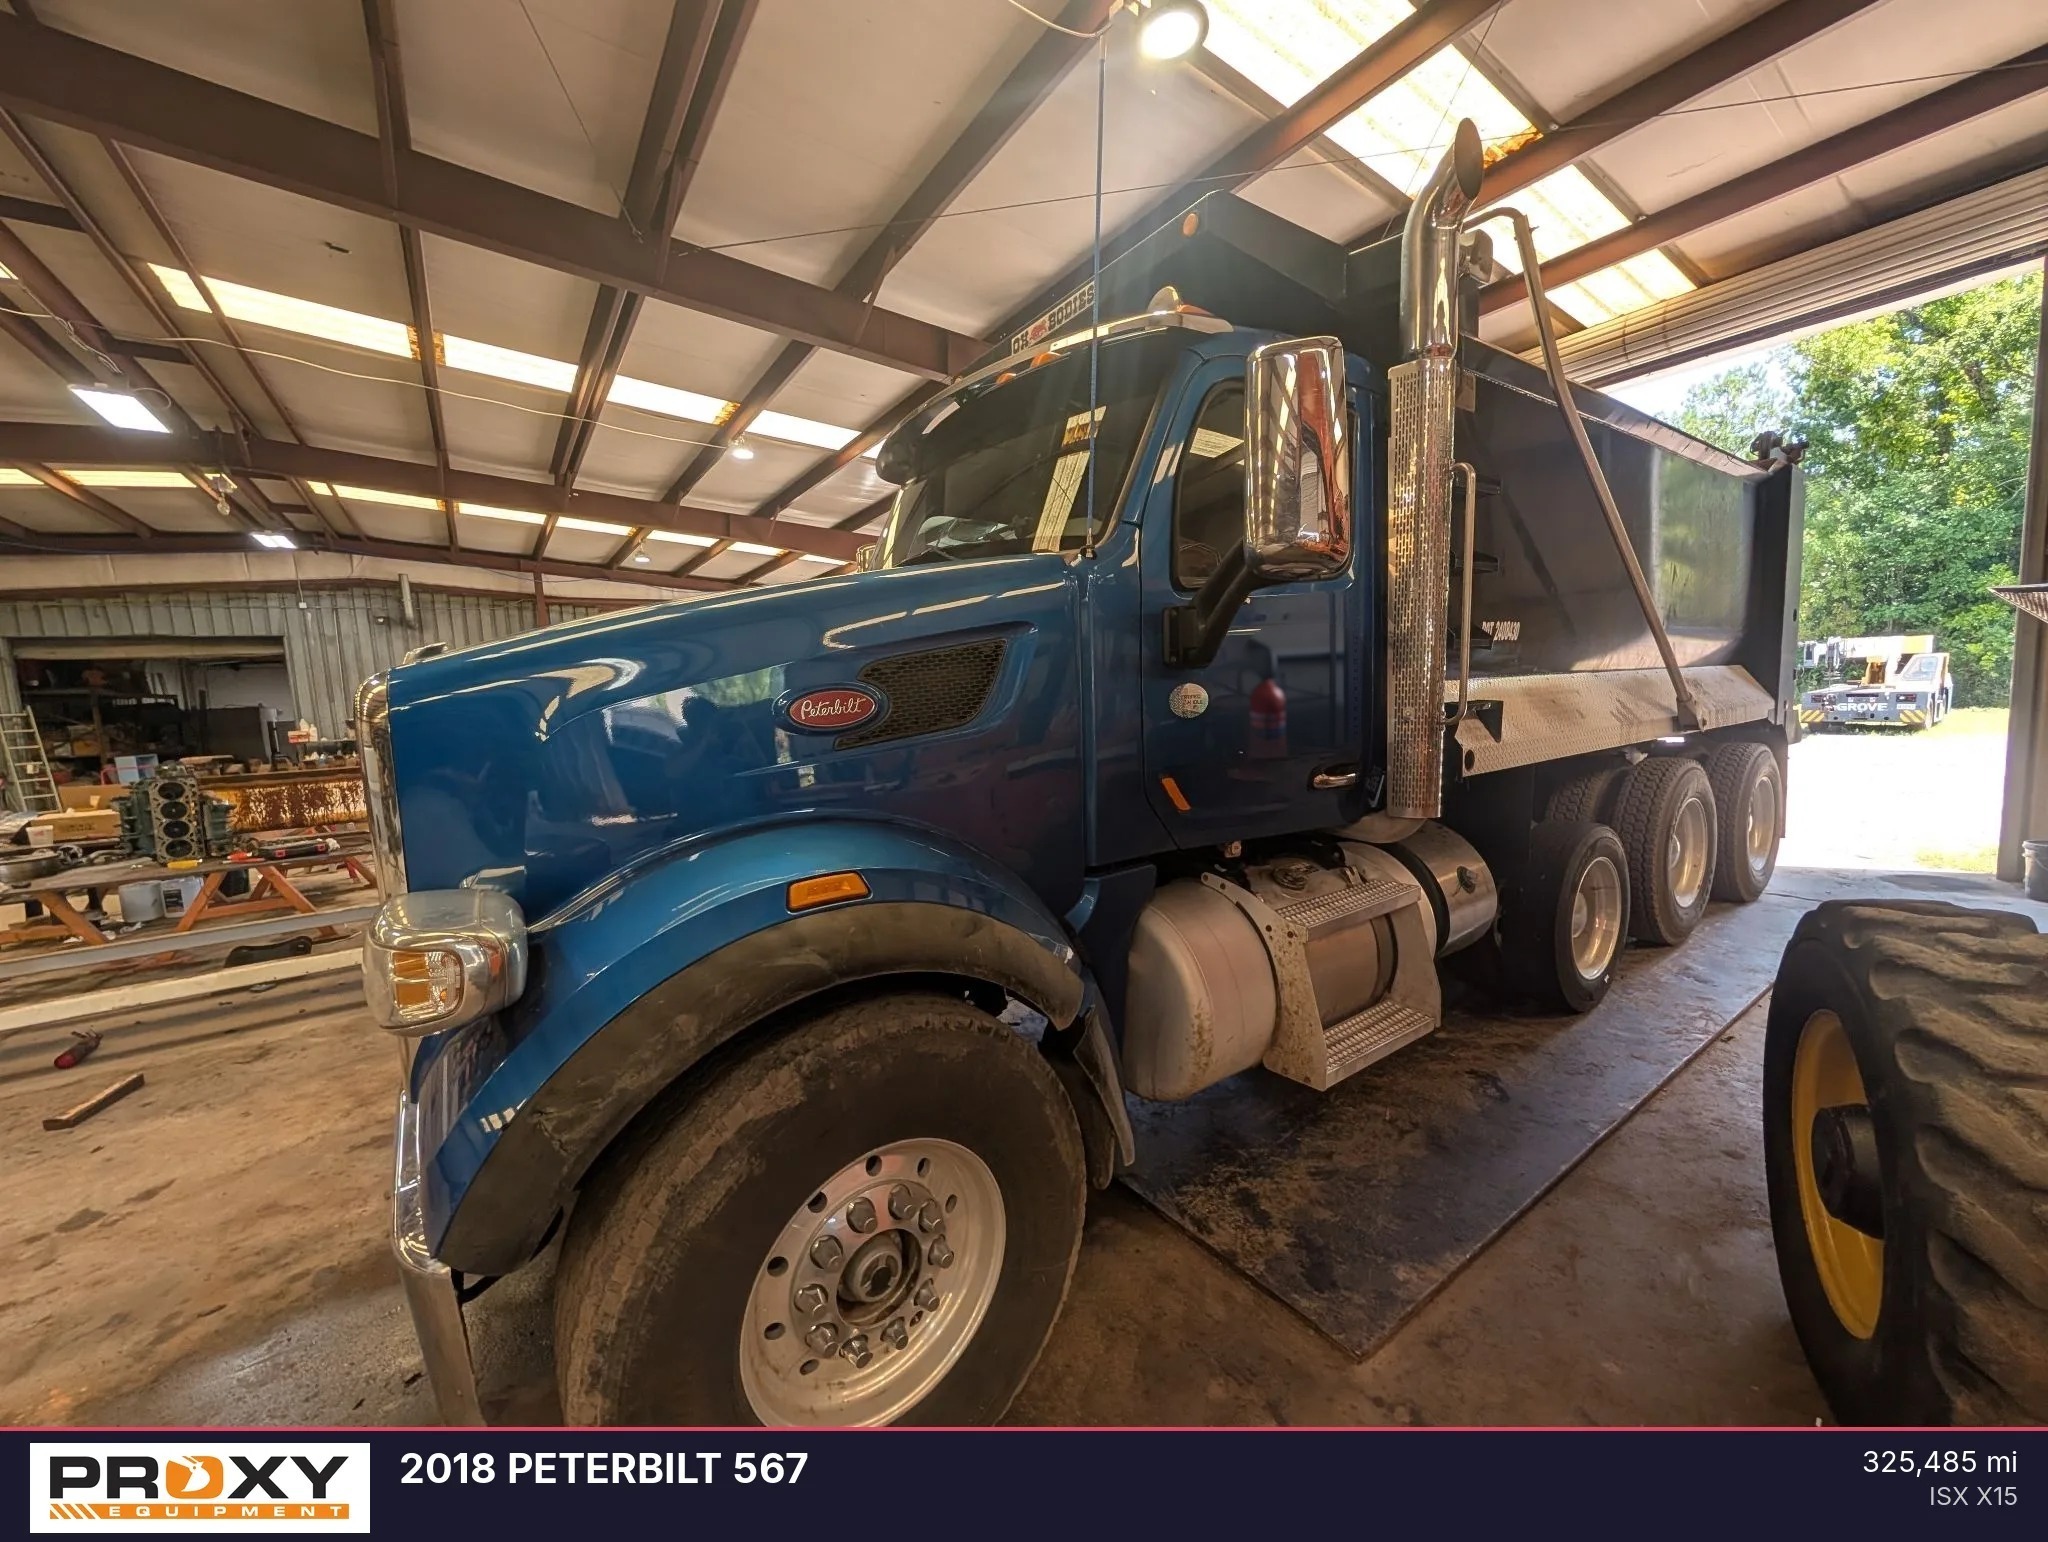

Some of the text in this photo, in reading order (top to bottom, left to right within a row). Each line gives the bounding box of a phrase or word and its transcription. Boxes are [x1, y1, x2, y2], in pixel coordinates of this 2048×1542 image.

[1047, 284, 1096, 332] BODIES
[800, 698, 867, 720] Peterbilt
[1837, 702, 1888, 712] GROVE
